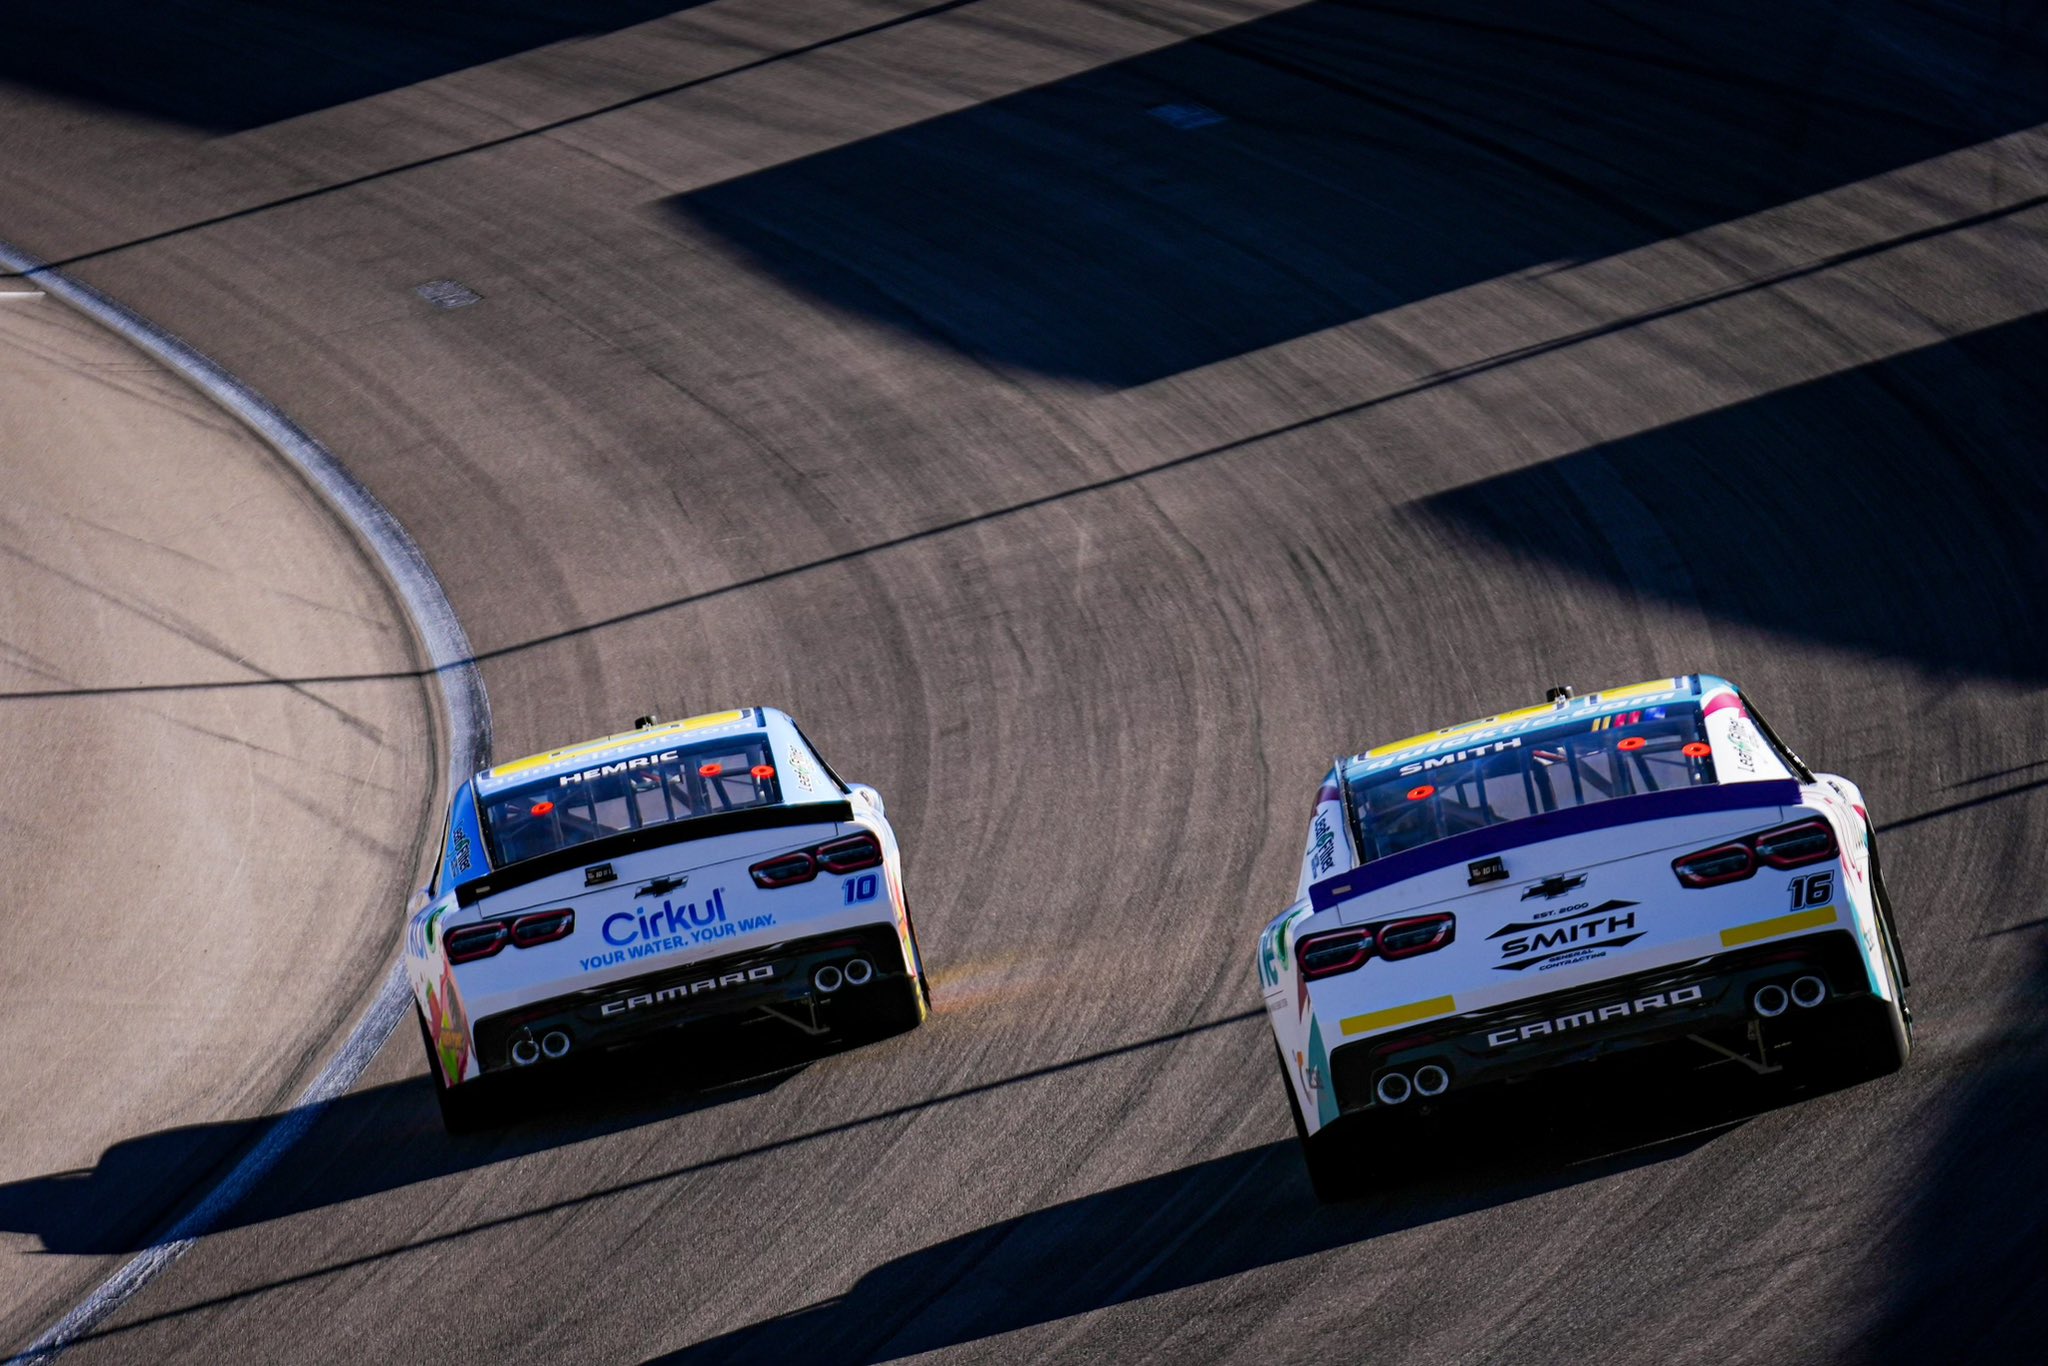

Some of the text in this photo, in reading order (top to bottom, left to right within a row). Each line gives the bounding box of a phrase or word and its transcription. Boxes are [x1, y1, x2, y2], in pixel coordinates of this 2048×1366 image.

[560, 750, 679, 787] HEMRIC
[1400, 738, 1522, 777] SMITH
[842, 872, 879, 905] 10
[1787, 869, 1834, 911] 16
[602, 887, 727, 946] Cirkul
[1533, 902, 1589, 920] EST. 2000
[580, 914, 777, 971] YOUR WATER. YOUR WAY.
[1501, 912, 1636, 959] SMITH
[1548, 948, 1594, 962] GENERAL
[1539, 951, 1607, 971] CONTRACTING
[601, 964, 775, 1016] CAMARO
[1487, 984, 1703, 1047] CAMARO
